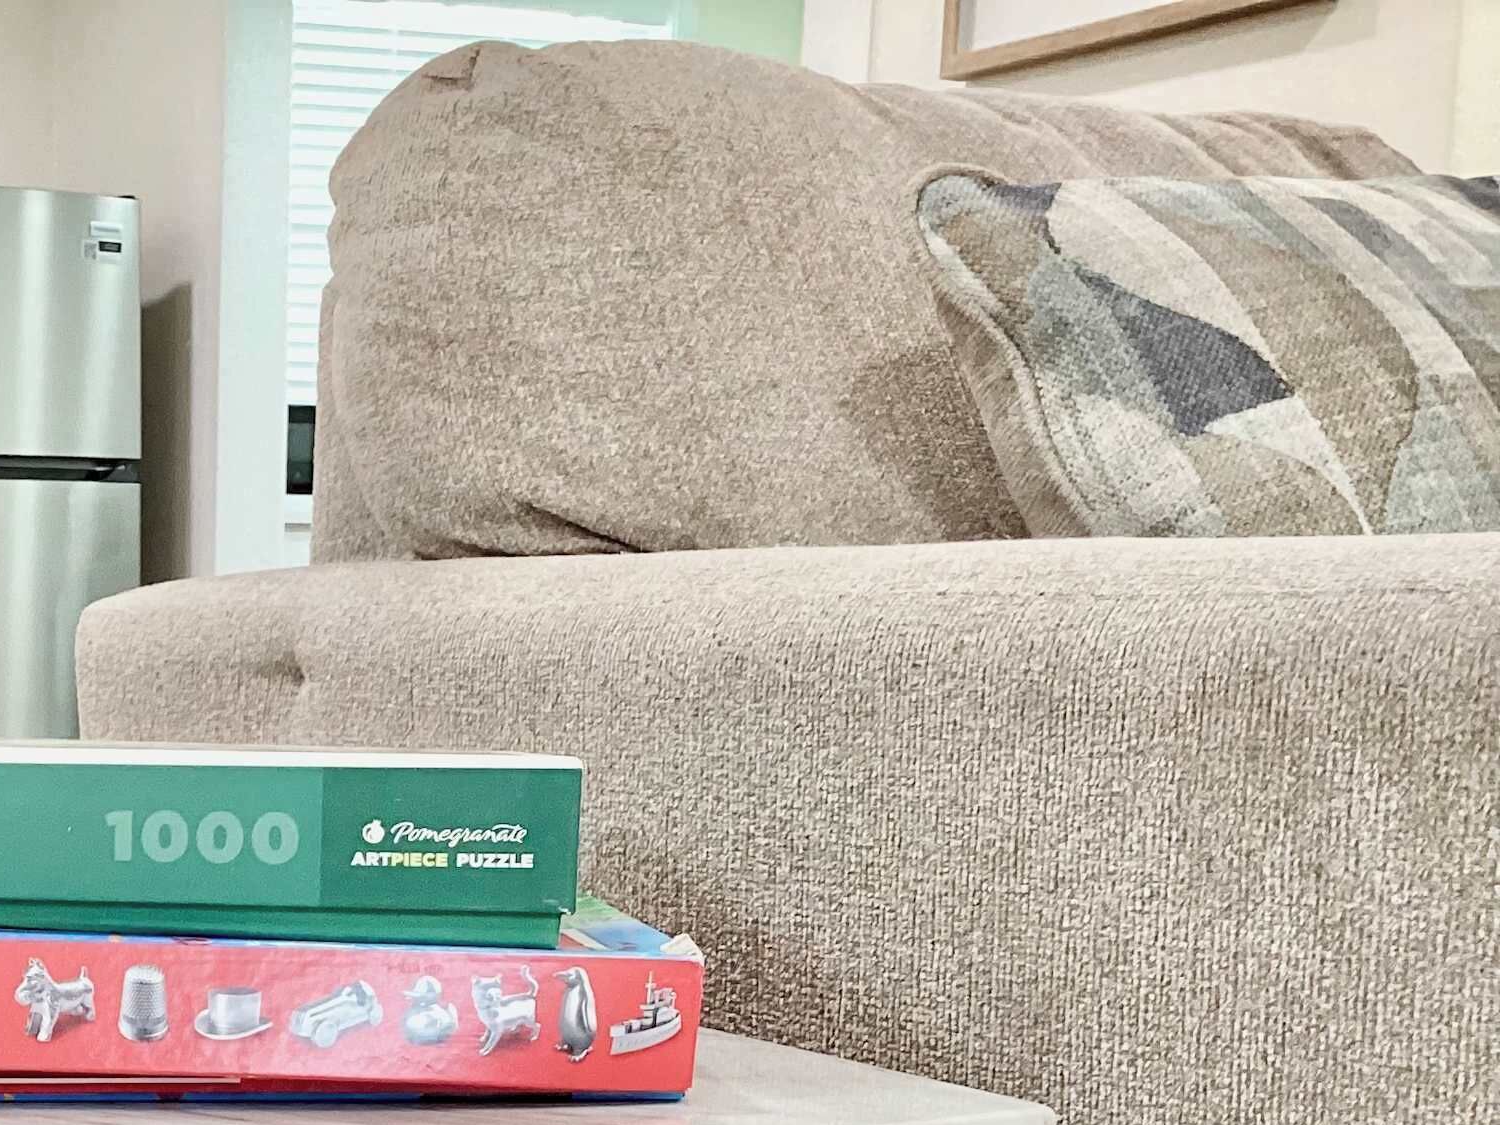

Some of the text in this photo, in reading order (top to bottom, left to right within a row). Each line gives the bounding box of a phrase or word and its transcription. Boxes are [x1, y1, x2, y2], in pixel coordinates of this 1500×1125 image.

[104, 809, 300, 865] 1000
[389, 821, 528, 848] Pomegranate
[350, 852, 535, 869] ARTPIECE PUZZLE
